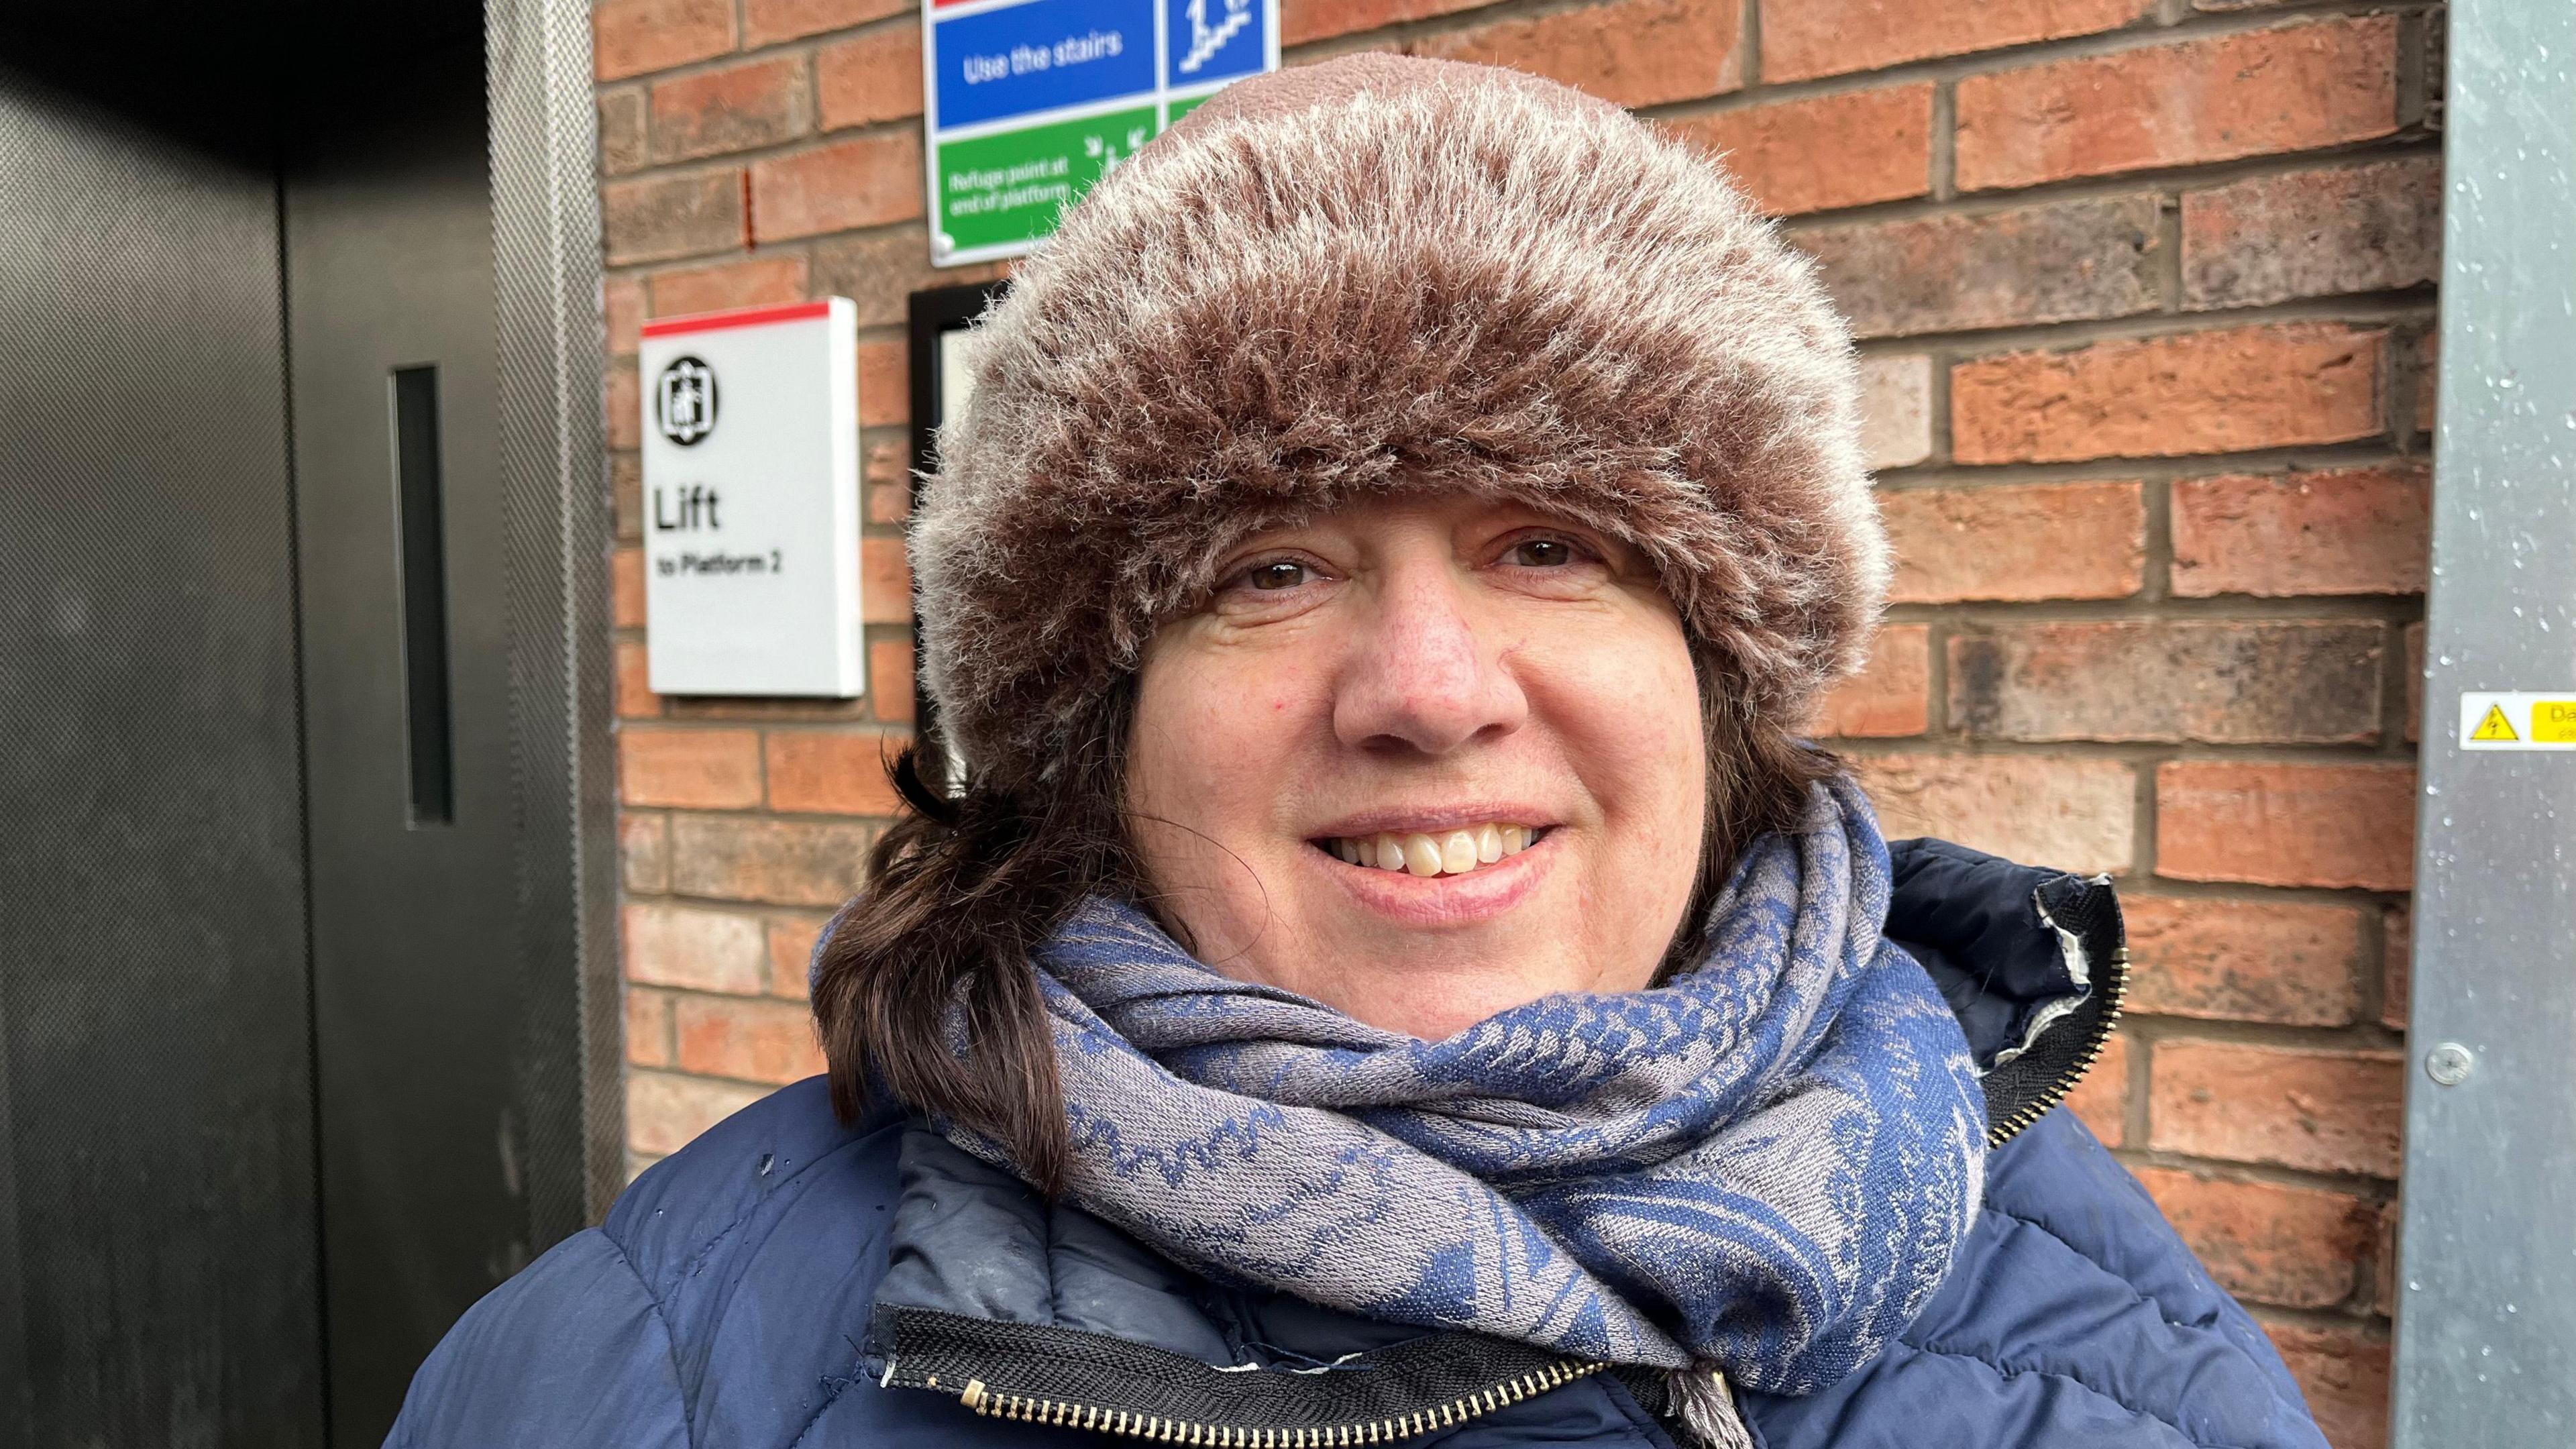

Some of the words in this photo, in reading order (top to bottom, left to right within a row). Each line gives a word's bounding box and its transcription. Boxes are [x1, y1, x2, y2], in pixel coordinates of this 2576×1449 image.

[963, 54, 1010, 85] Use
[1011, 43, 1051, 75] the
[1053, 29, 1123, 66] stairs
[949, 169, 1004, 193] Refuge
[1006, 159, 1048, 186] point
[1051, 155, 1069, 175] at
[949, 195, 980, 217] and
[981, 191, 997, 212] of
[998, 182, 1071, 212] platform
[653, 484, 719, 532] Lift
[657, 557, 674, 576] to
[680, 551, 765, 574] Platform
[769, 549, 782, 574] 2
